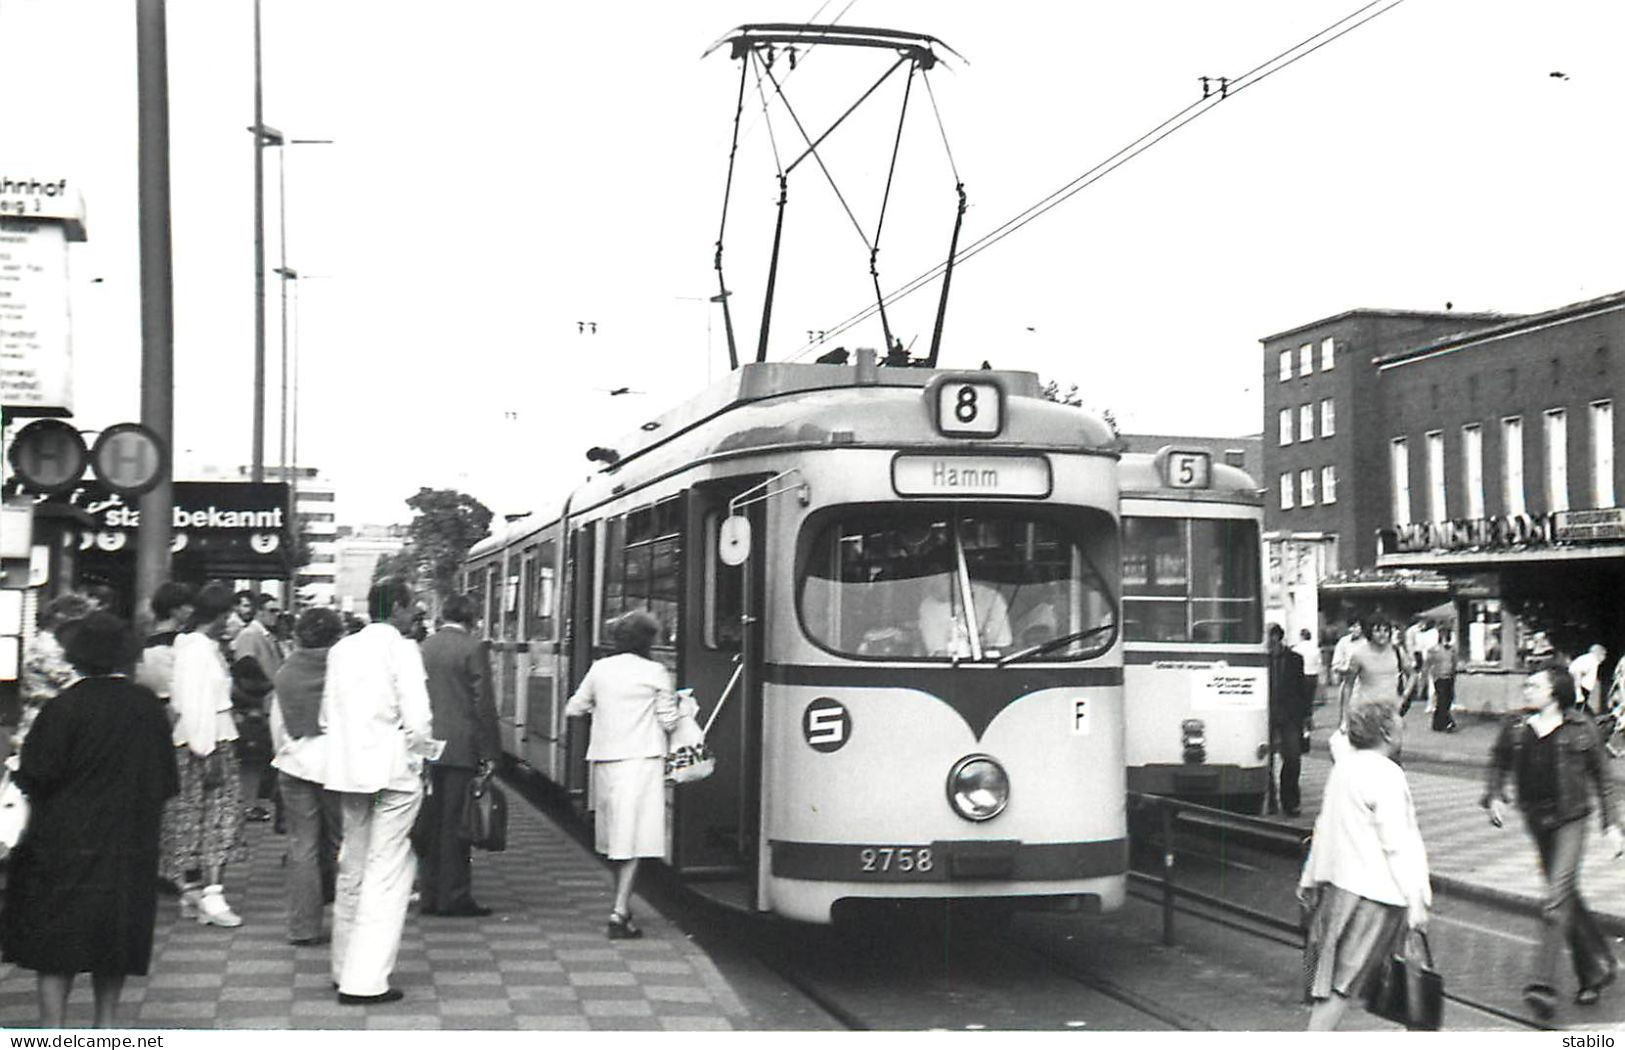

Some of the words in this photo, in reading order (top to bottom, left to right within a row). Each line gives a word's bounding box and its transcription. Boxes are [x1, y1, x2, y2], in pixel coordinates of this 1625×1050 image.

[0, 176, 66, 196] hnhof
[955, 386, 977, 423] 8
[110, 438, 147, 480] H
[1179, 458, 1195, 484] 5
[933, 461, 998, 486] Hamm
[1076, 702, 1085, 731] F
[860, 848, 934, 873] 2758
